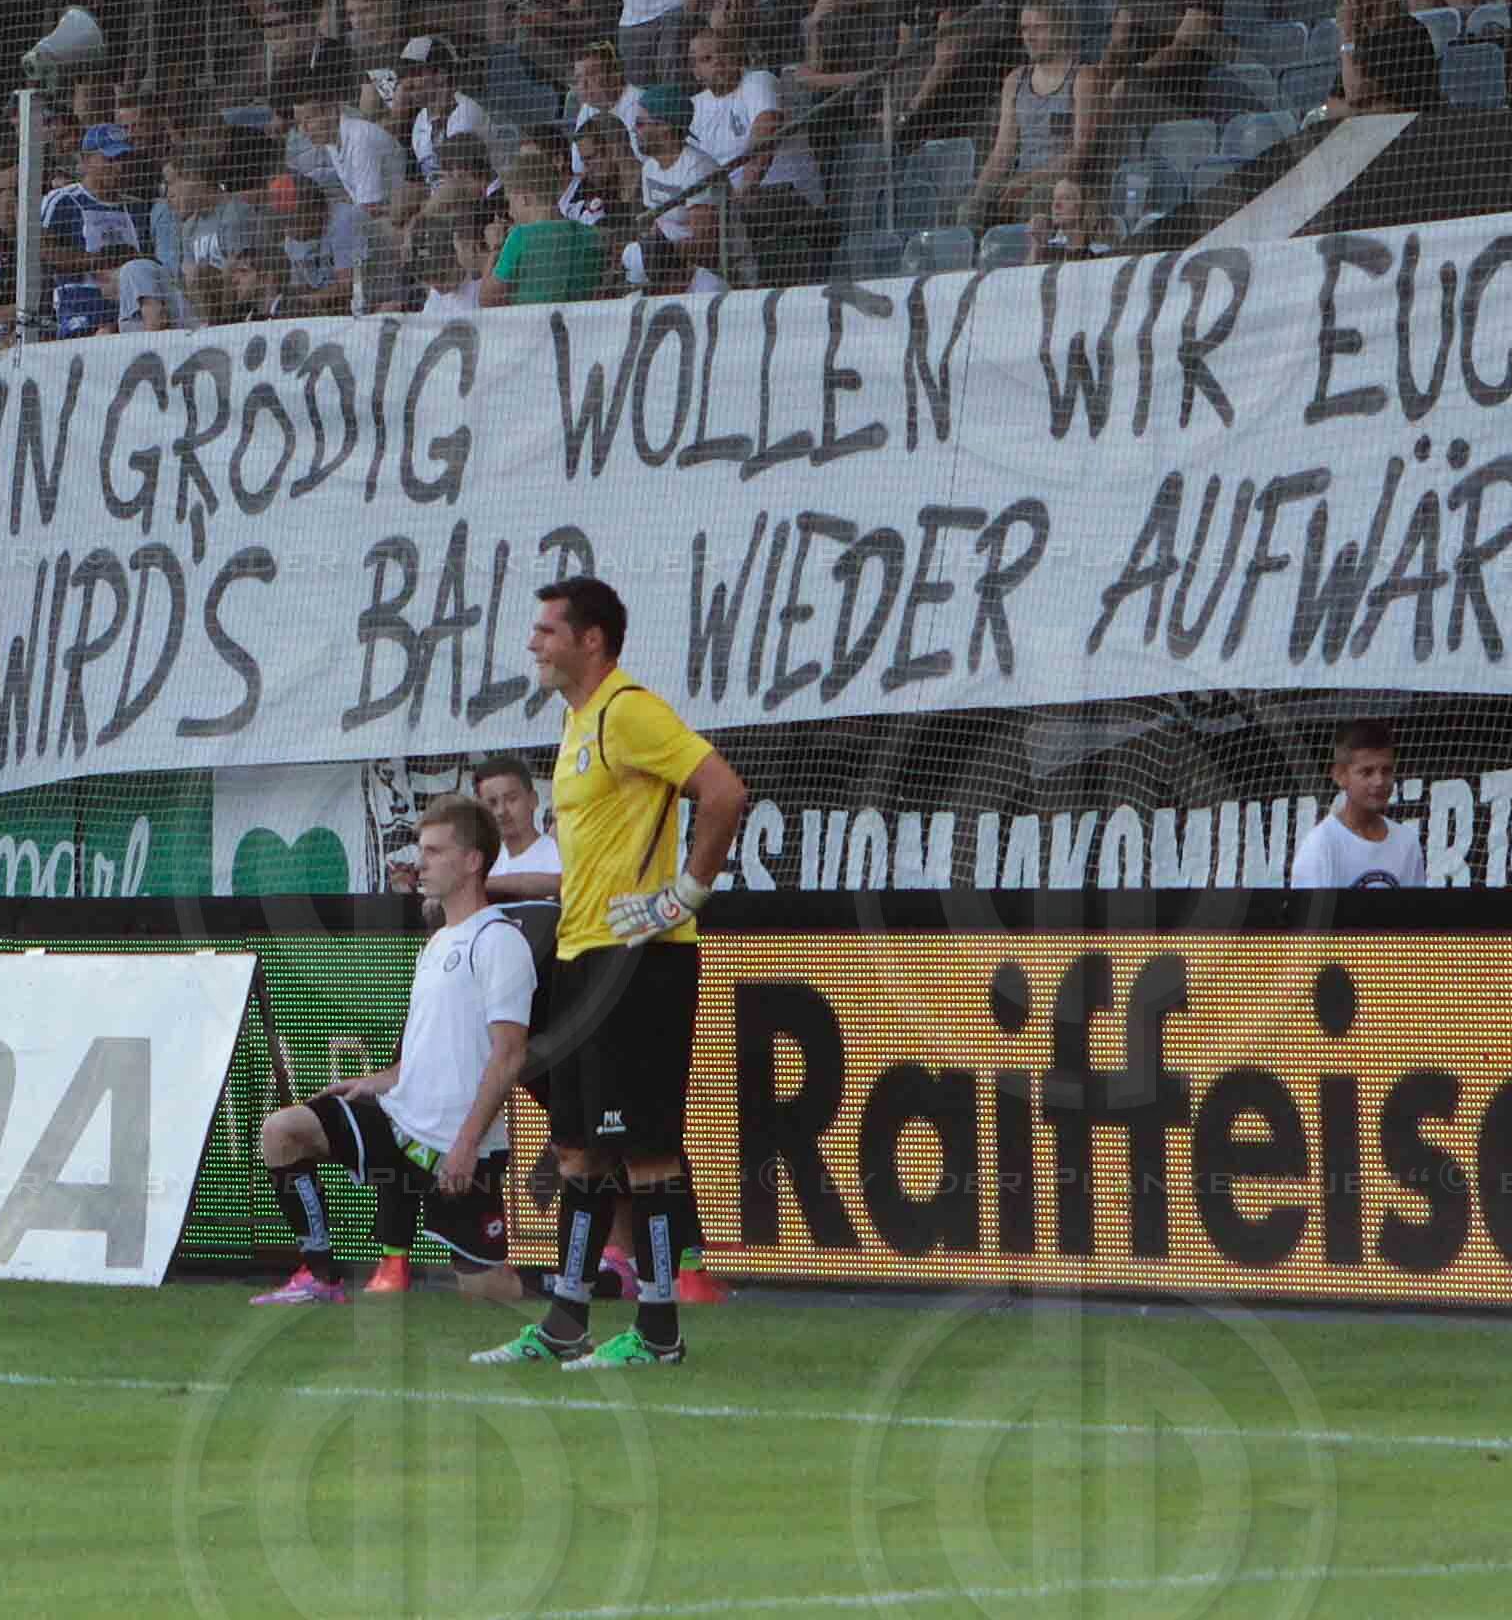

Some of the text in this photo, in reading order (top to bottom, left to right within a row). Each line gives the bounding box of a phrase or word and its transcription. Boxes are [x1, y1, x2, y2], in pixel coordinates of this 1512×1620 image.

[99, 316, 480, 534] GRÖDIG
[550, 263, 986, 480] WOLLEN
[1041, 247, 1252, 441] WIR
[686, 497, 1050, 710] WIEDER
